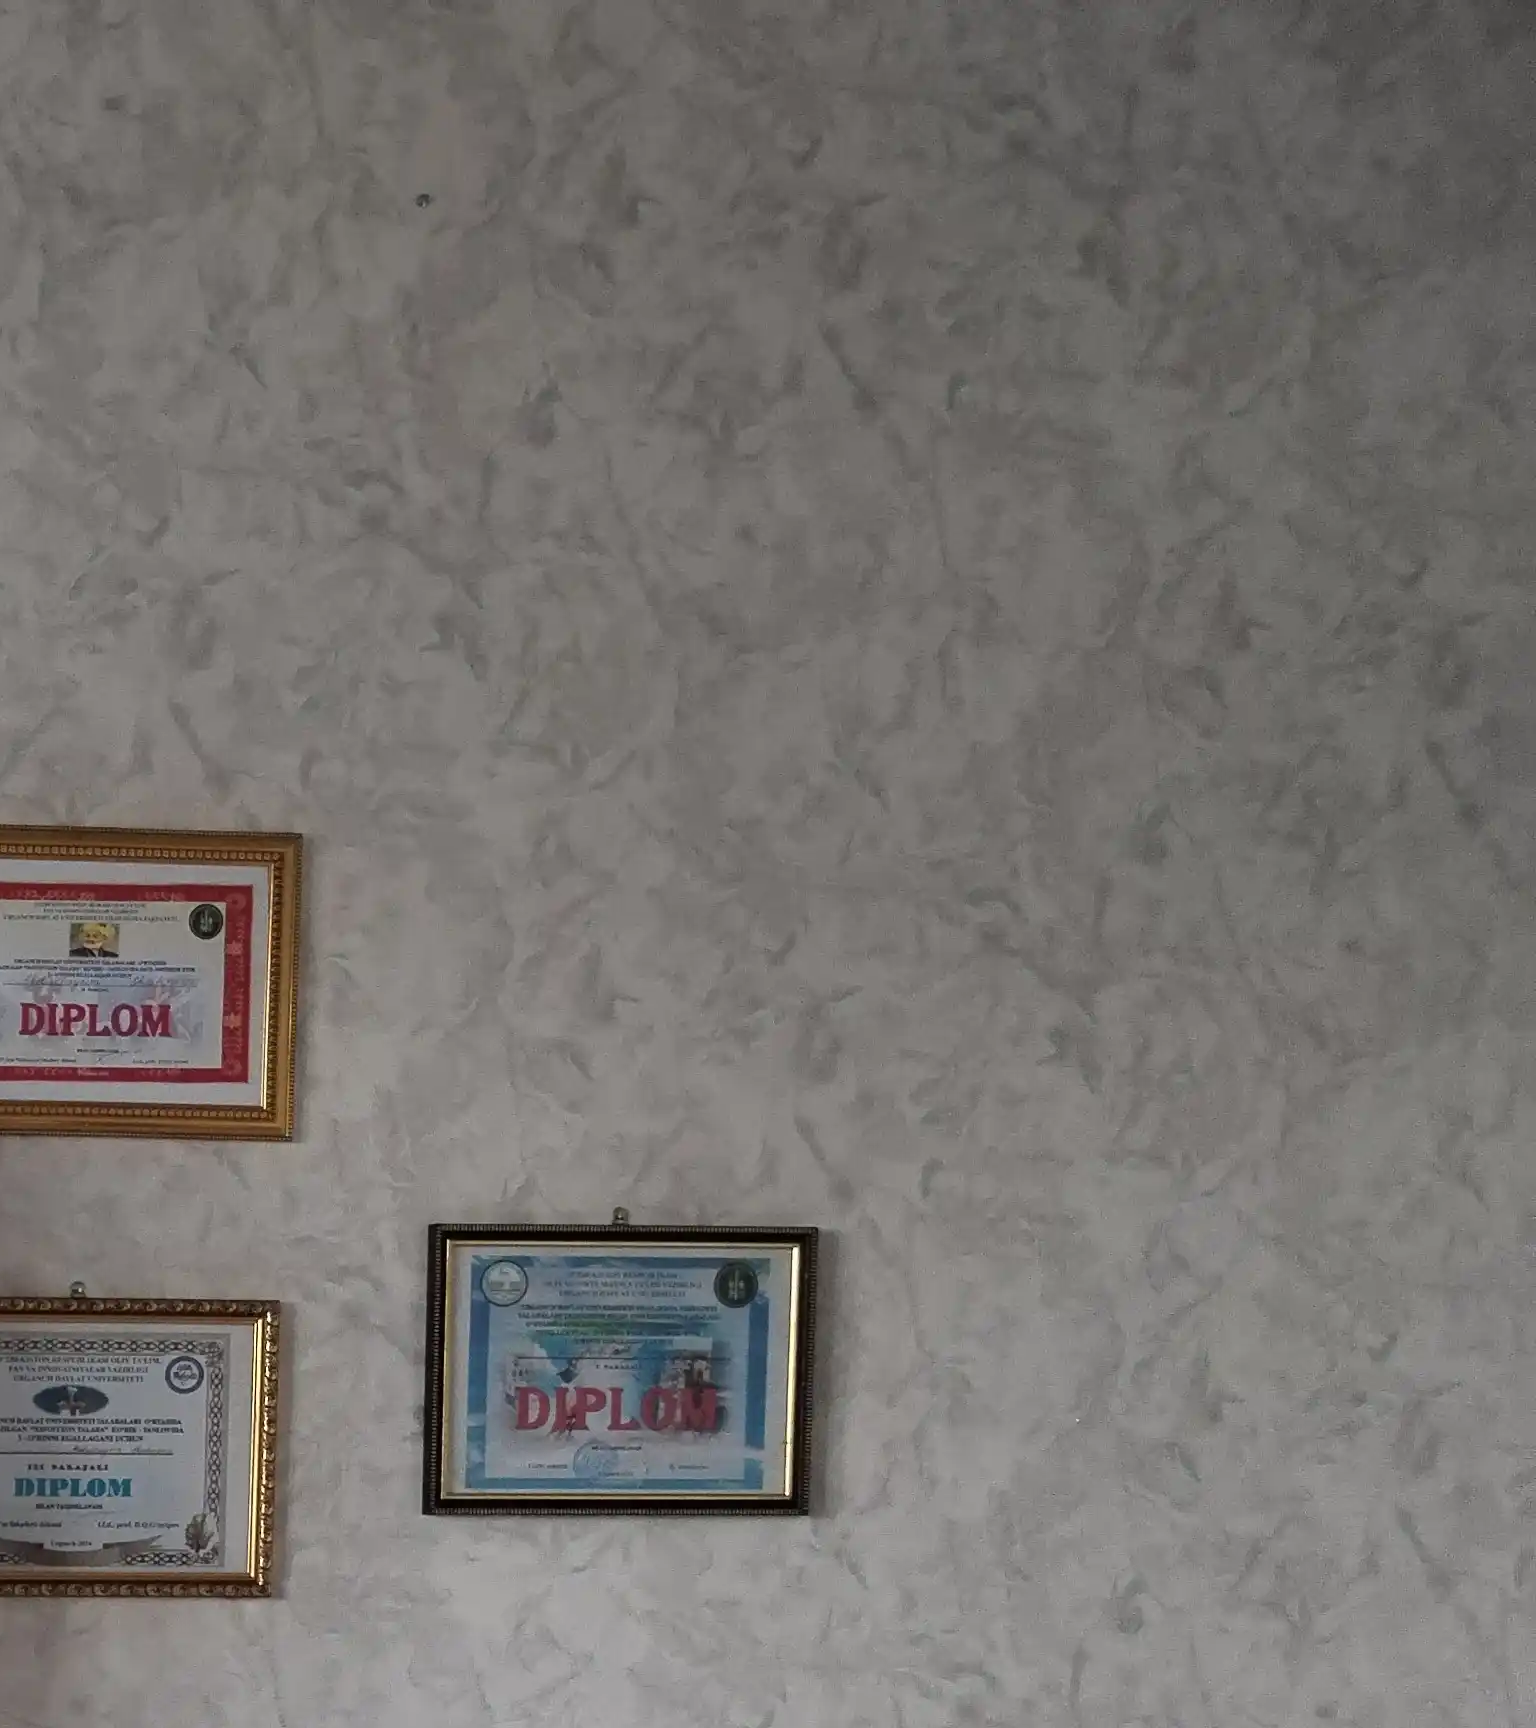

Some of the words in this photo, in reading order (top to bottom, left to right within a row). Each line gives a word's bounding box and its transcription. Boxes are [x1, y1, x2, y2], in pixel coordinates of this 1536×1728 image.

[18, 1003, 173, 1039] DIPLOM
[514, 1385, 721, 1433] DIPLOM
[13, 1477, 133, 1498] DIPLOM
